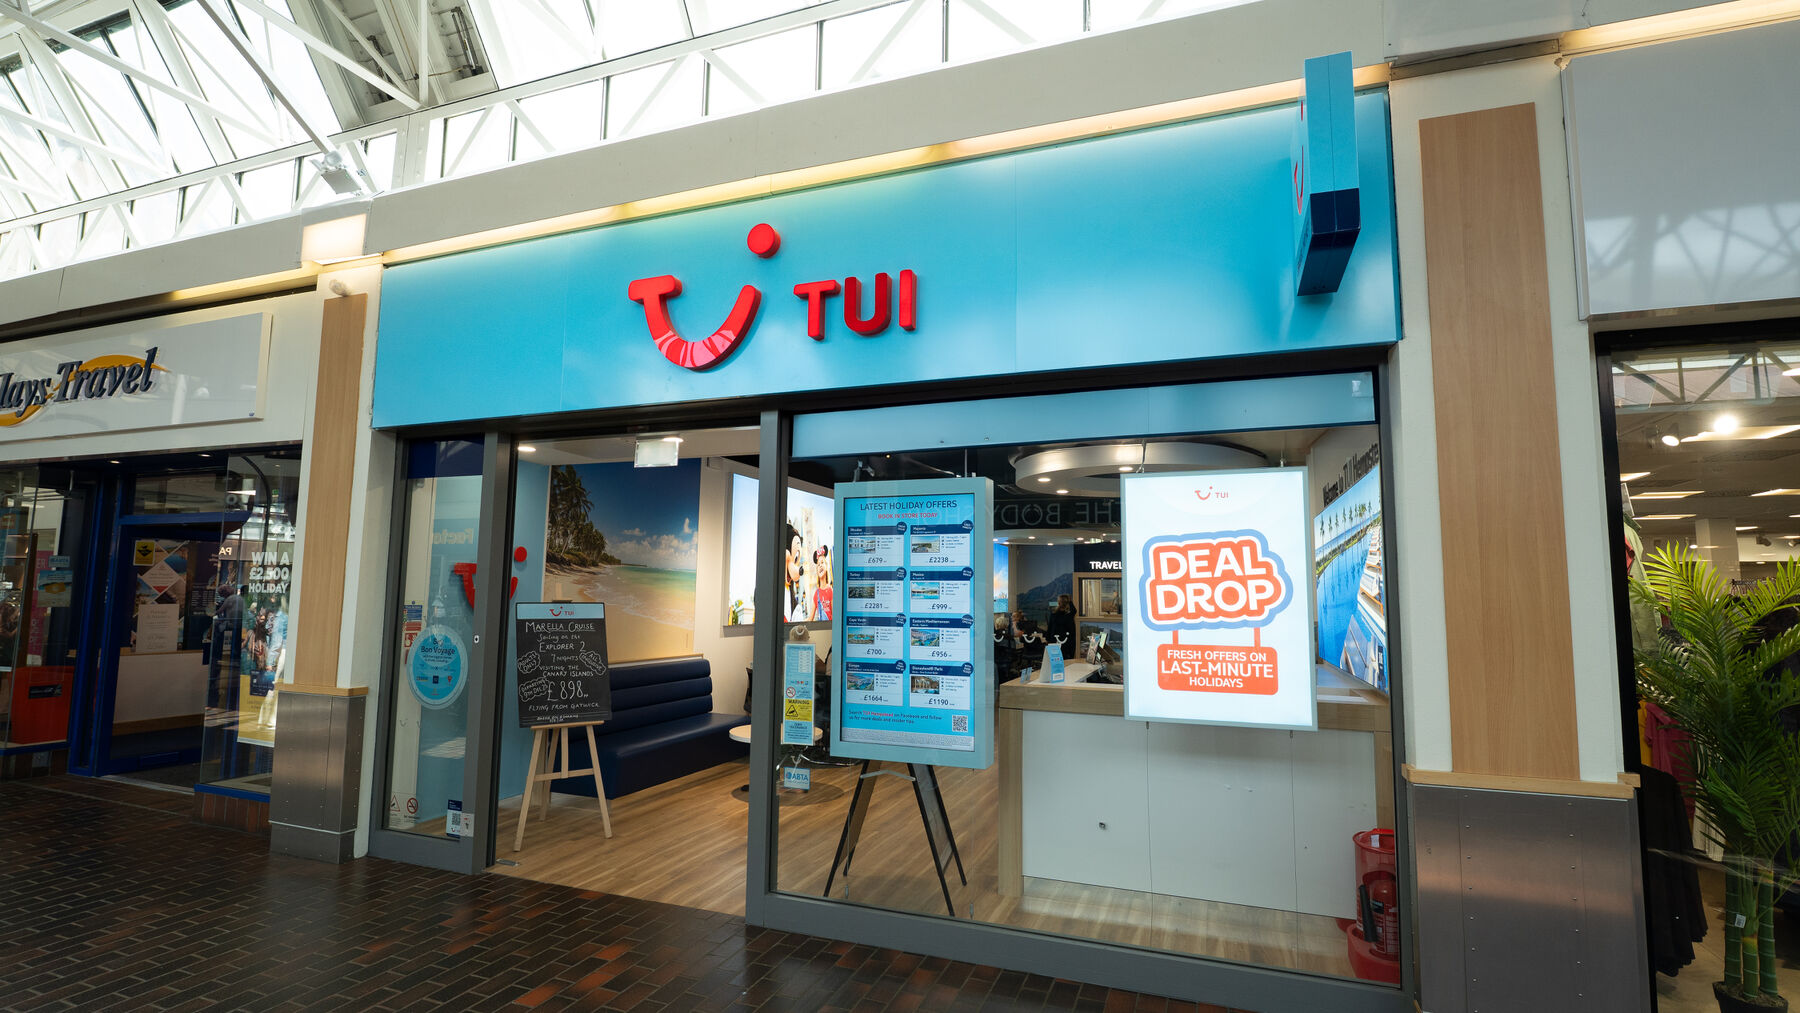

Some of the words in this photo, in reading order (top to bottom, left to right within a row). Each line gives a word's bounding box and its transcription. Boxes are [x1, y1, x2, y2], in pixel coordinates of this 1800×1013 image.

[794, 269, 918, 341] TUI
[54, 346, 158, 403] Travel
[860, 502, 887, 511] LATEST
[890, 501, 924, 510] HOLIDAY
[926, 500, 957, 509] OFFERS
[252, 551, 278, 566] WIN
[280, 552, 289, 565] A
[1159, 546, 1266, 580] DEAL
[249, 582, 289, 594] HOLIDAY
[1156, 579, 1274, 615] DROP
[434, 646, 456, 656] Voyage
[580, 642, 586, 652] 2
[1167, 650, 1201, 660] FRESH
[1205, 650, 1246, 662] OFFERS
[1250, 652, 1266, 662] ON
[1161, 660, 1273, 678] LAST-MINUTE
[1189, 676, 1243, 688] HOLIDAYS
